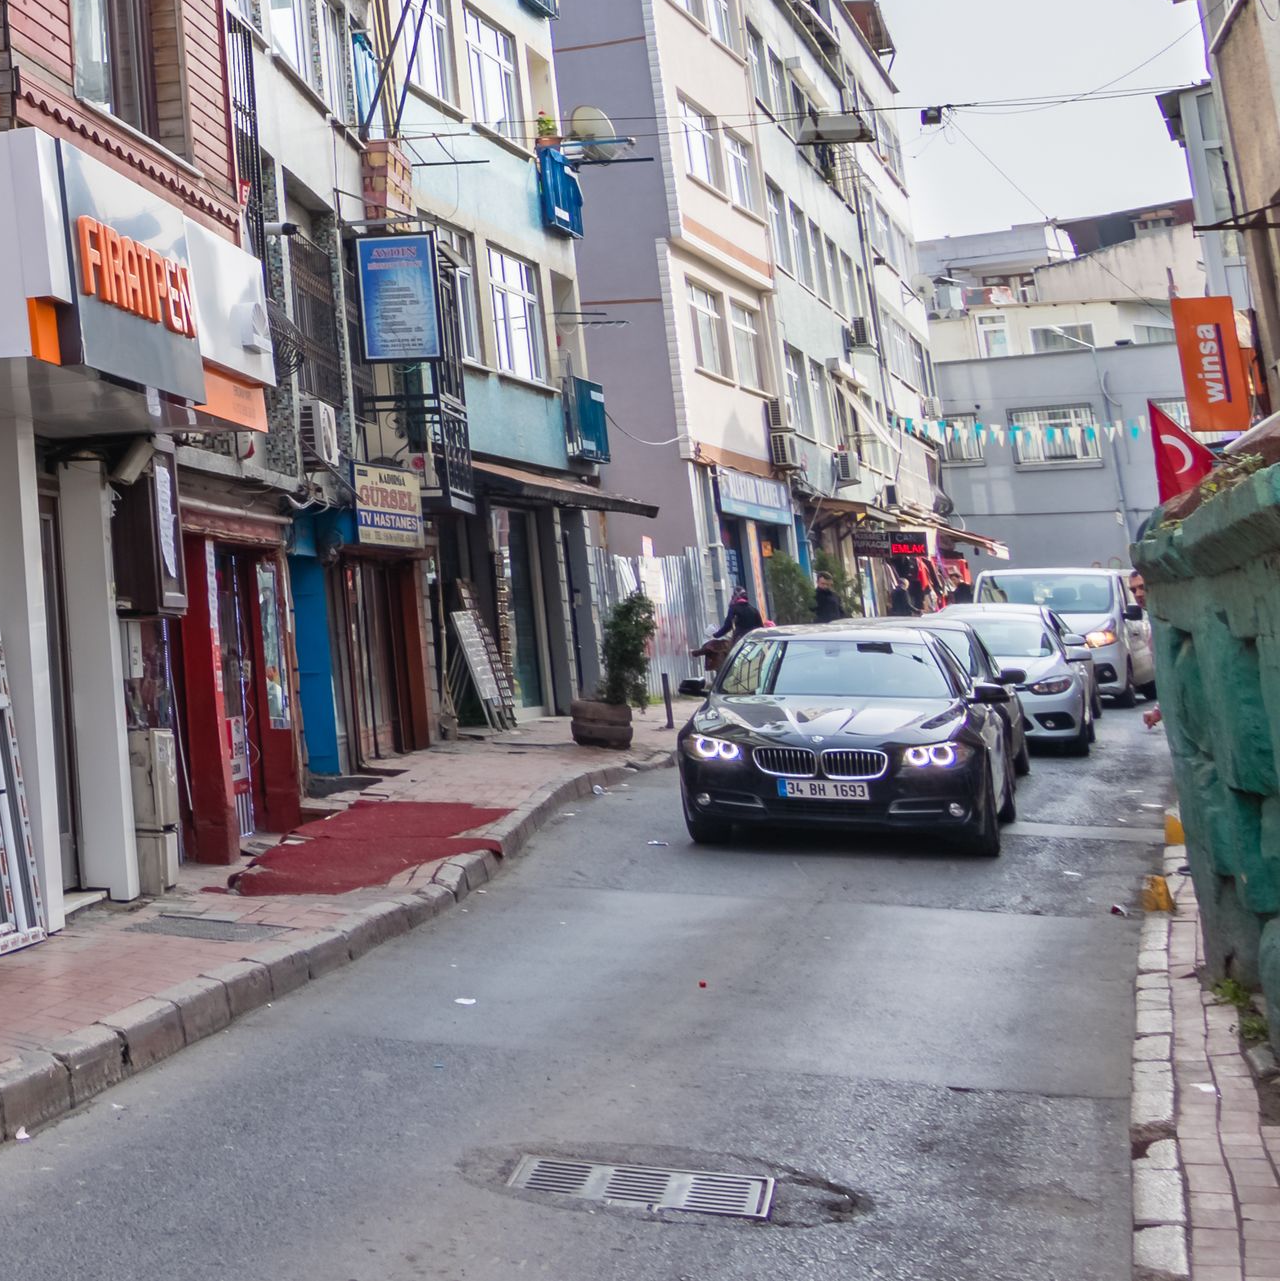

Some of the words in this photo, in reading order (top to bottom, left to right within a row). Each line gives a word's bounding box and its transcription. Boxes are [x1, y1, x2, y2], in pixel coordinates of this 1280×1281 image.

[77, 214, 196, 339] FIRATPEN
[1197, 323, 1225, 404] winsa
[360, 481, 417, 512] GÜRSEL
[360, 511, 372, 524] TV
[891, 543, 925, 554] EMLAK
[787, 782, 803, 795] 34
[809, 783, 826, 796] BH
[833, 784, 866, 798] 1693
